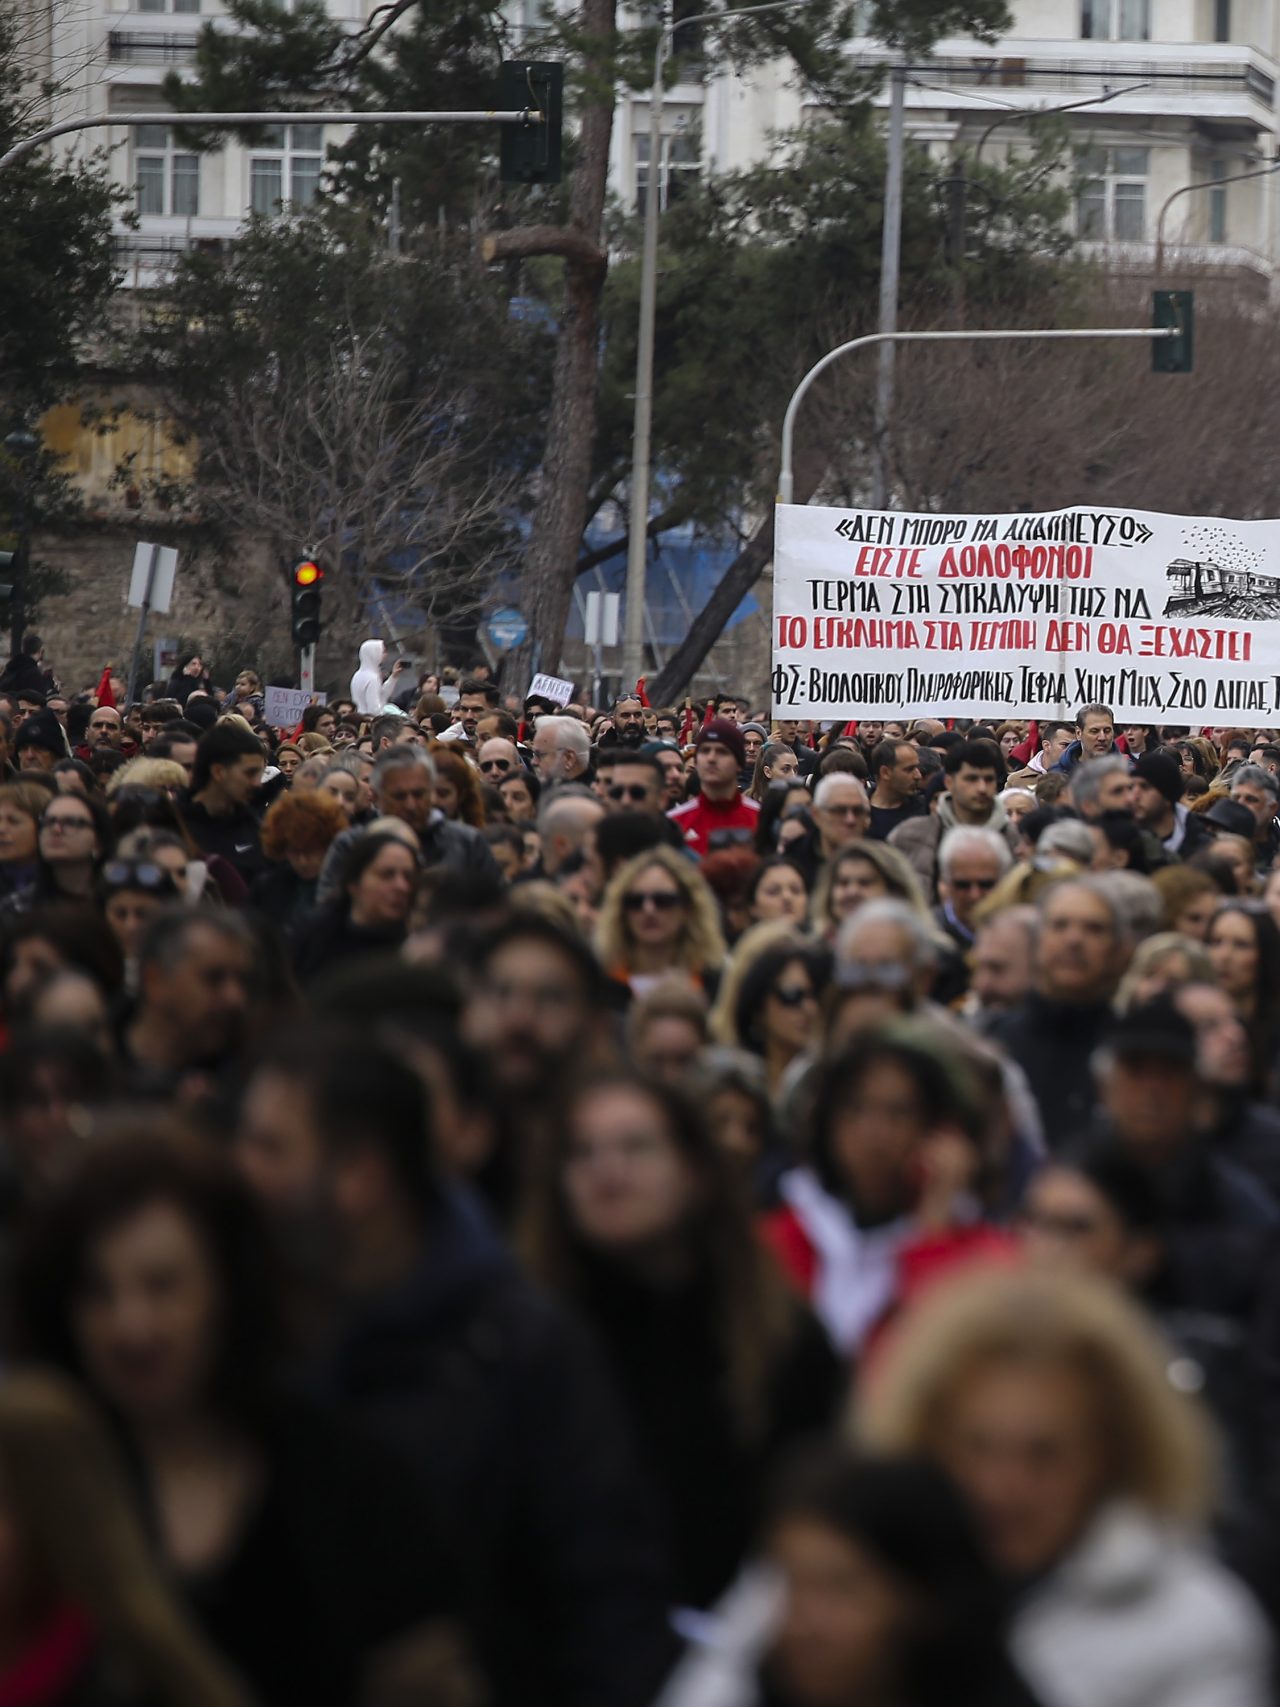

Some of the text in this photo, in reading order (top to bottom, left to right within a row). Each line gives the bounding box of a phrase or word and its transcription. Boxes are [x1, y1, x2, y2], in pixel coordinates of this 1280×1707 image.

[834, 514, 894, 545] «ΔΕΝ
[899, 517, 968, 546] ΜΠΟΡΩ
[971, 519, 997, 542] ΝΑ
[854, 543, 1093, 580] ΕΙΣΤΕ ΔΟΛΟΦΟΝΟΙ
[806, 579, 1152, 620] ΤΕΡΜΑ ΣΤΗ ΣΥΓΚΑΛΥΨΗ ΤΗΣ ΝΔ
[776, 616, 1252, 662] ΤΟ ΕΓΚΛΗΜΑ ΣΤΑ ΤΕΜΠΗ ΔΕΝ ΘΑ ΞΕΧΑΣΤΕΙ
[1167, 672, 1207, 708] ΣΔΟ
